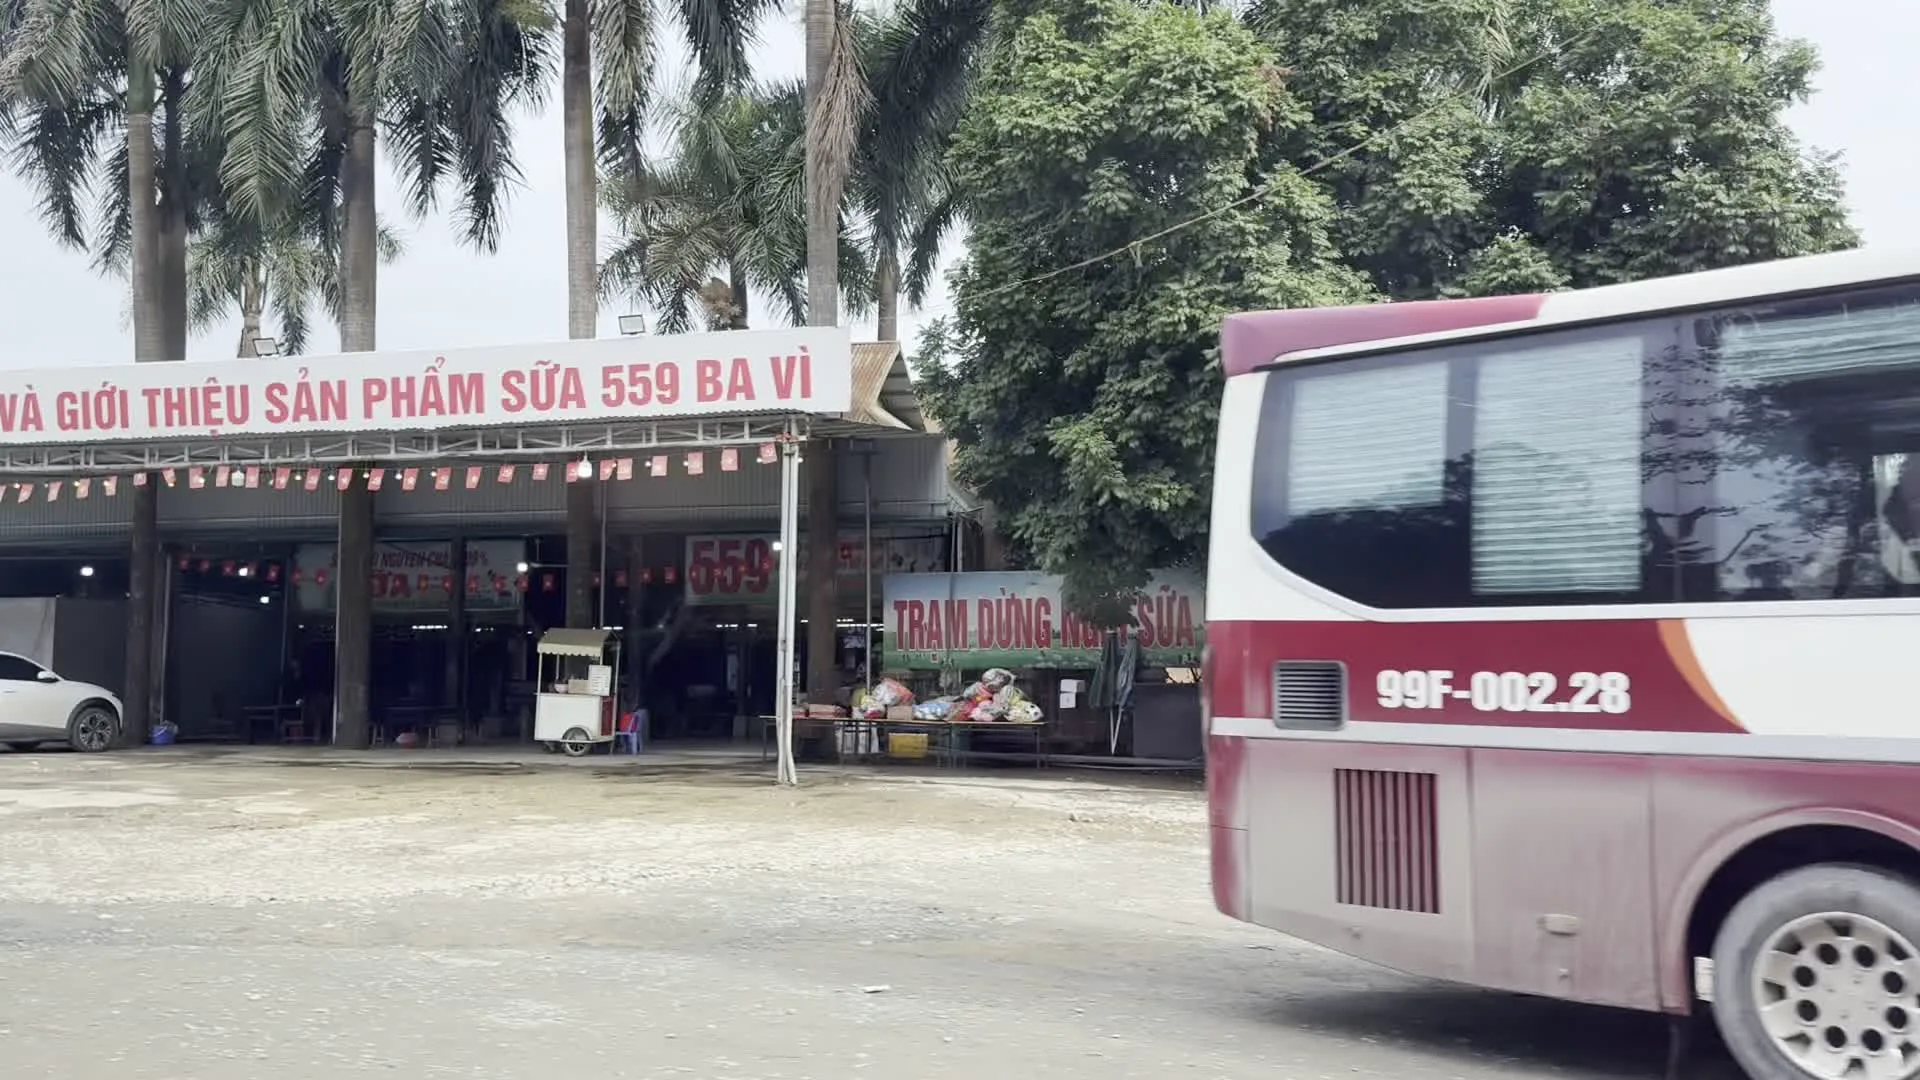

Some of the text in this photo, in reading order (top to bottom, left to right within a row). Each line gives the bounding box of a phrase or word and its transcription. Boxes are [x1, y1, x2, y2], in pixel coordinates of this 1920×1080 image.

[0, 345, 813, 440] VÀ GIỚI THIỆU SẢN PHẨM SỮA 559 BA VÌ
[689, 538, 773, 595] 559
[894, 600, 969, 663] TRẠM
[977, 586, 1052, 649] DỪNG
[1137, 585, 1196, 648] SỮA
[1376, 669, 1632, 714] 99F-002.28
